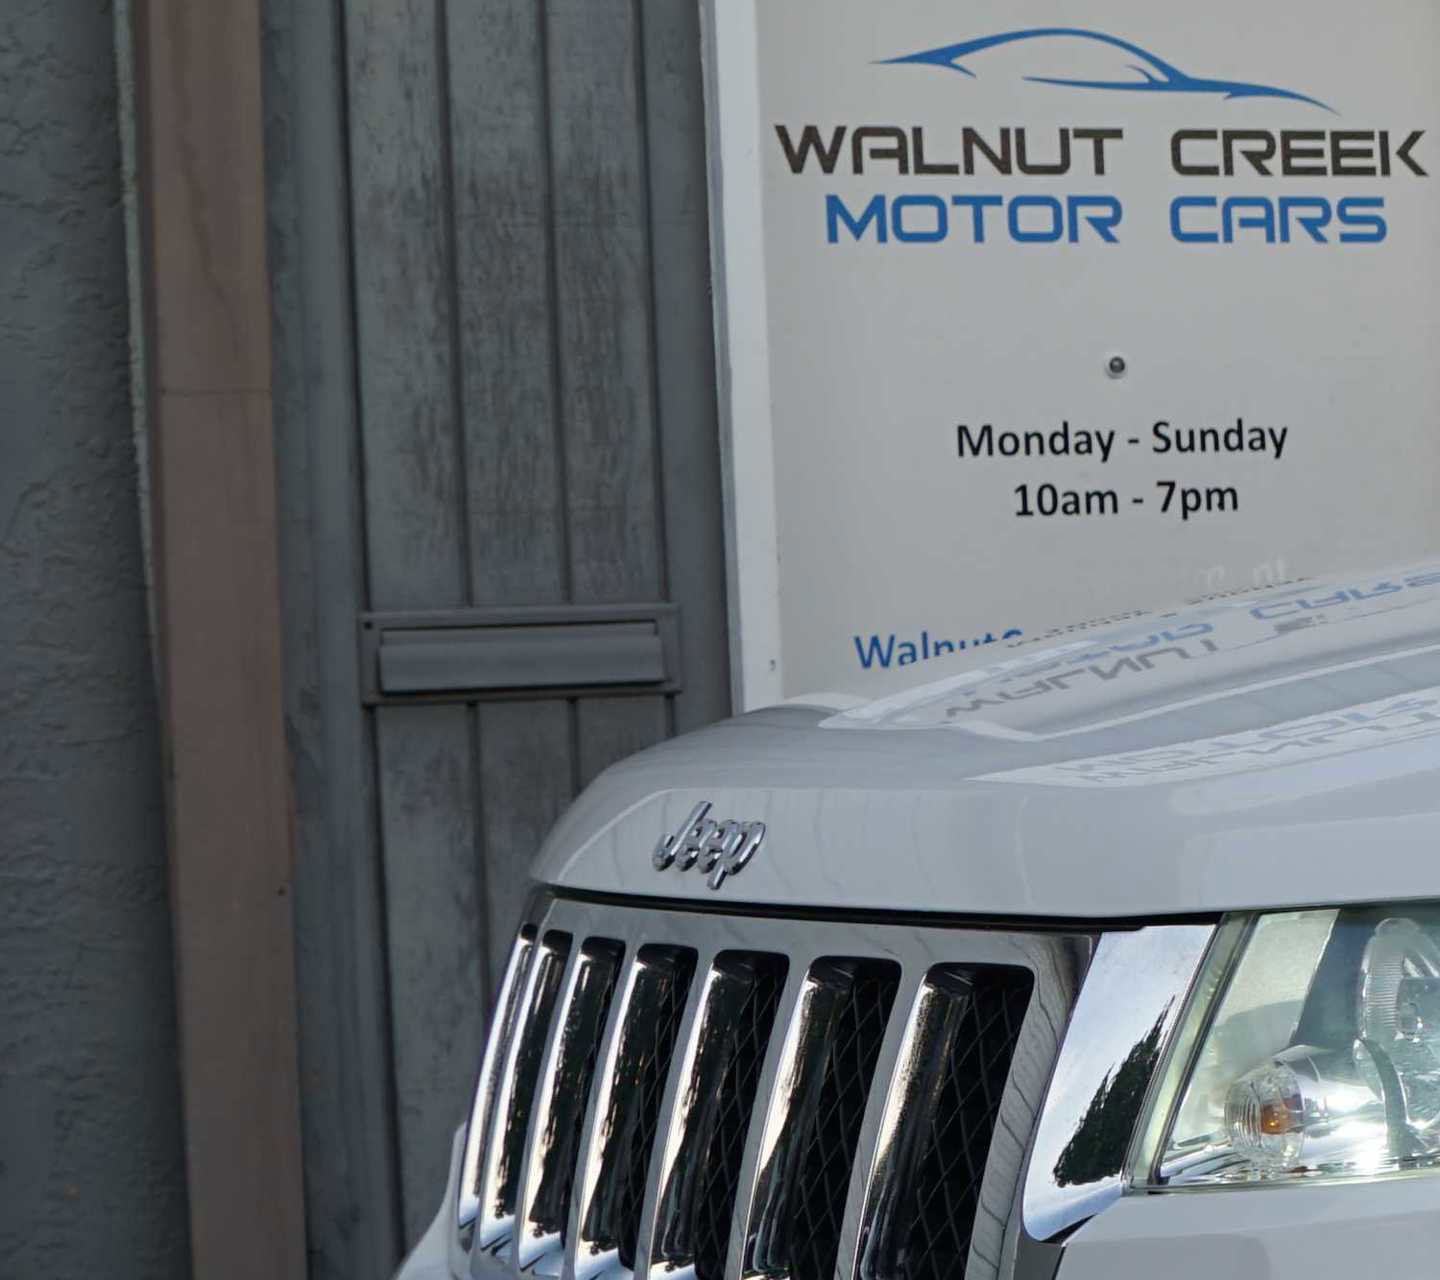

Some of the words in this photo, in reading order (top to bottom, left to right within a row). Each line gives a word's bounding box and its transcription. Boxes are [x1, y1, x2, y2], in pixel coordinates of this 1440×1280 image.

[775, 125, 1123, 176] WALNUT
[1171, 129, 1429, 177] CREEK
[826, 194, 1123, 244] MOTOR
[1169, 194, 1388, 244] CARS
[955, 423, 1116, 461] Monday
[1151, 420, 1288, 459] Sunday
[1013, 484, 1121, 517] 10am
[1155, 482, 1239, 520] 7pm
[652, 800, 766, 890] Jeep
